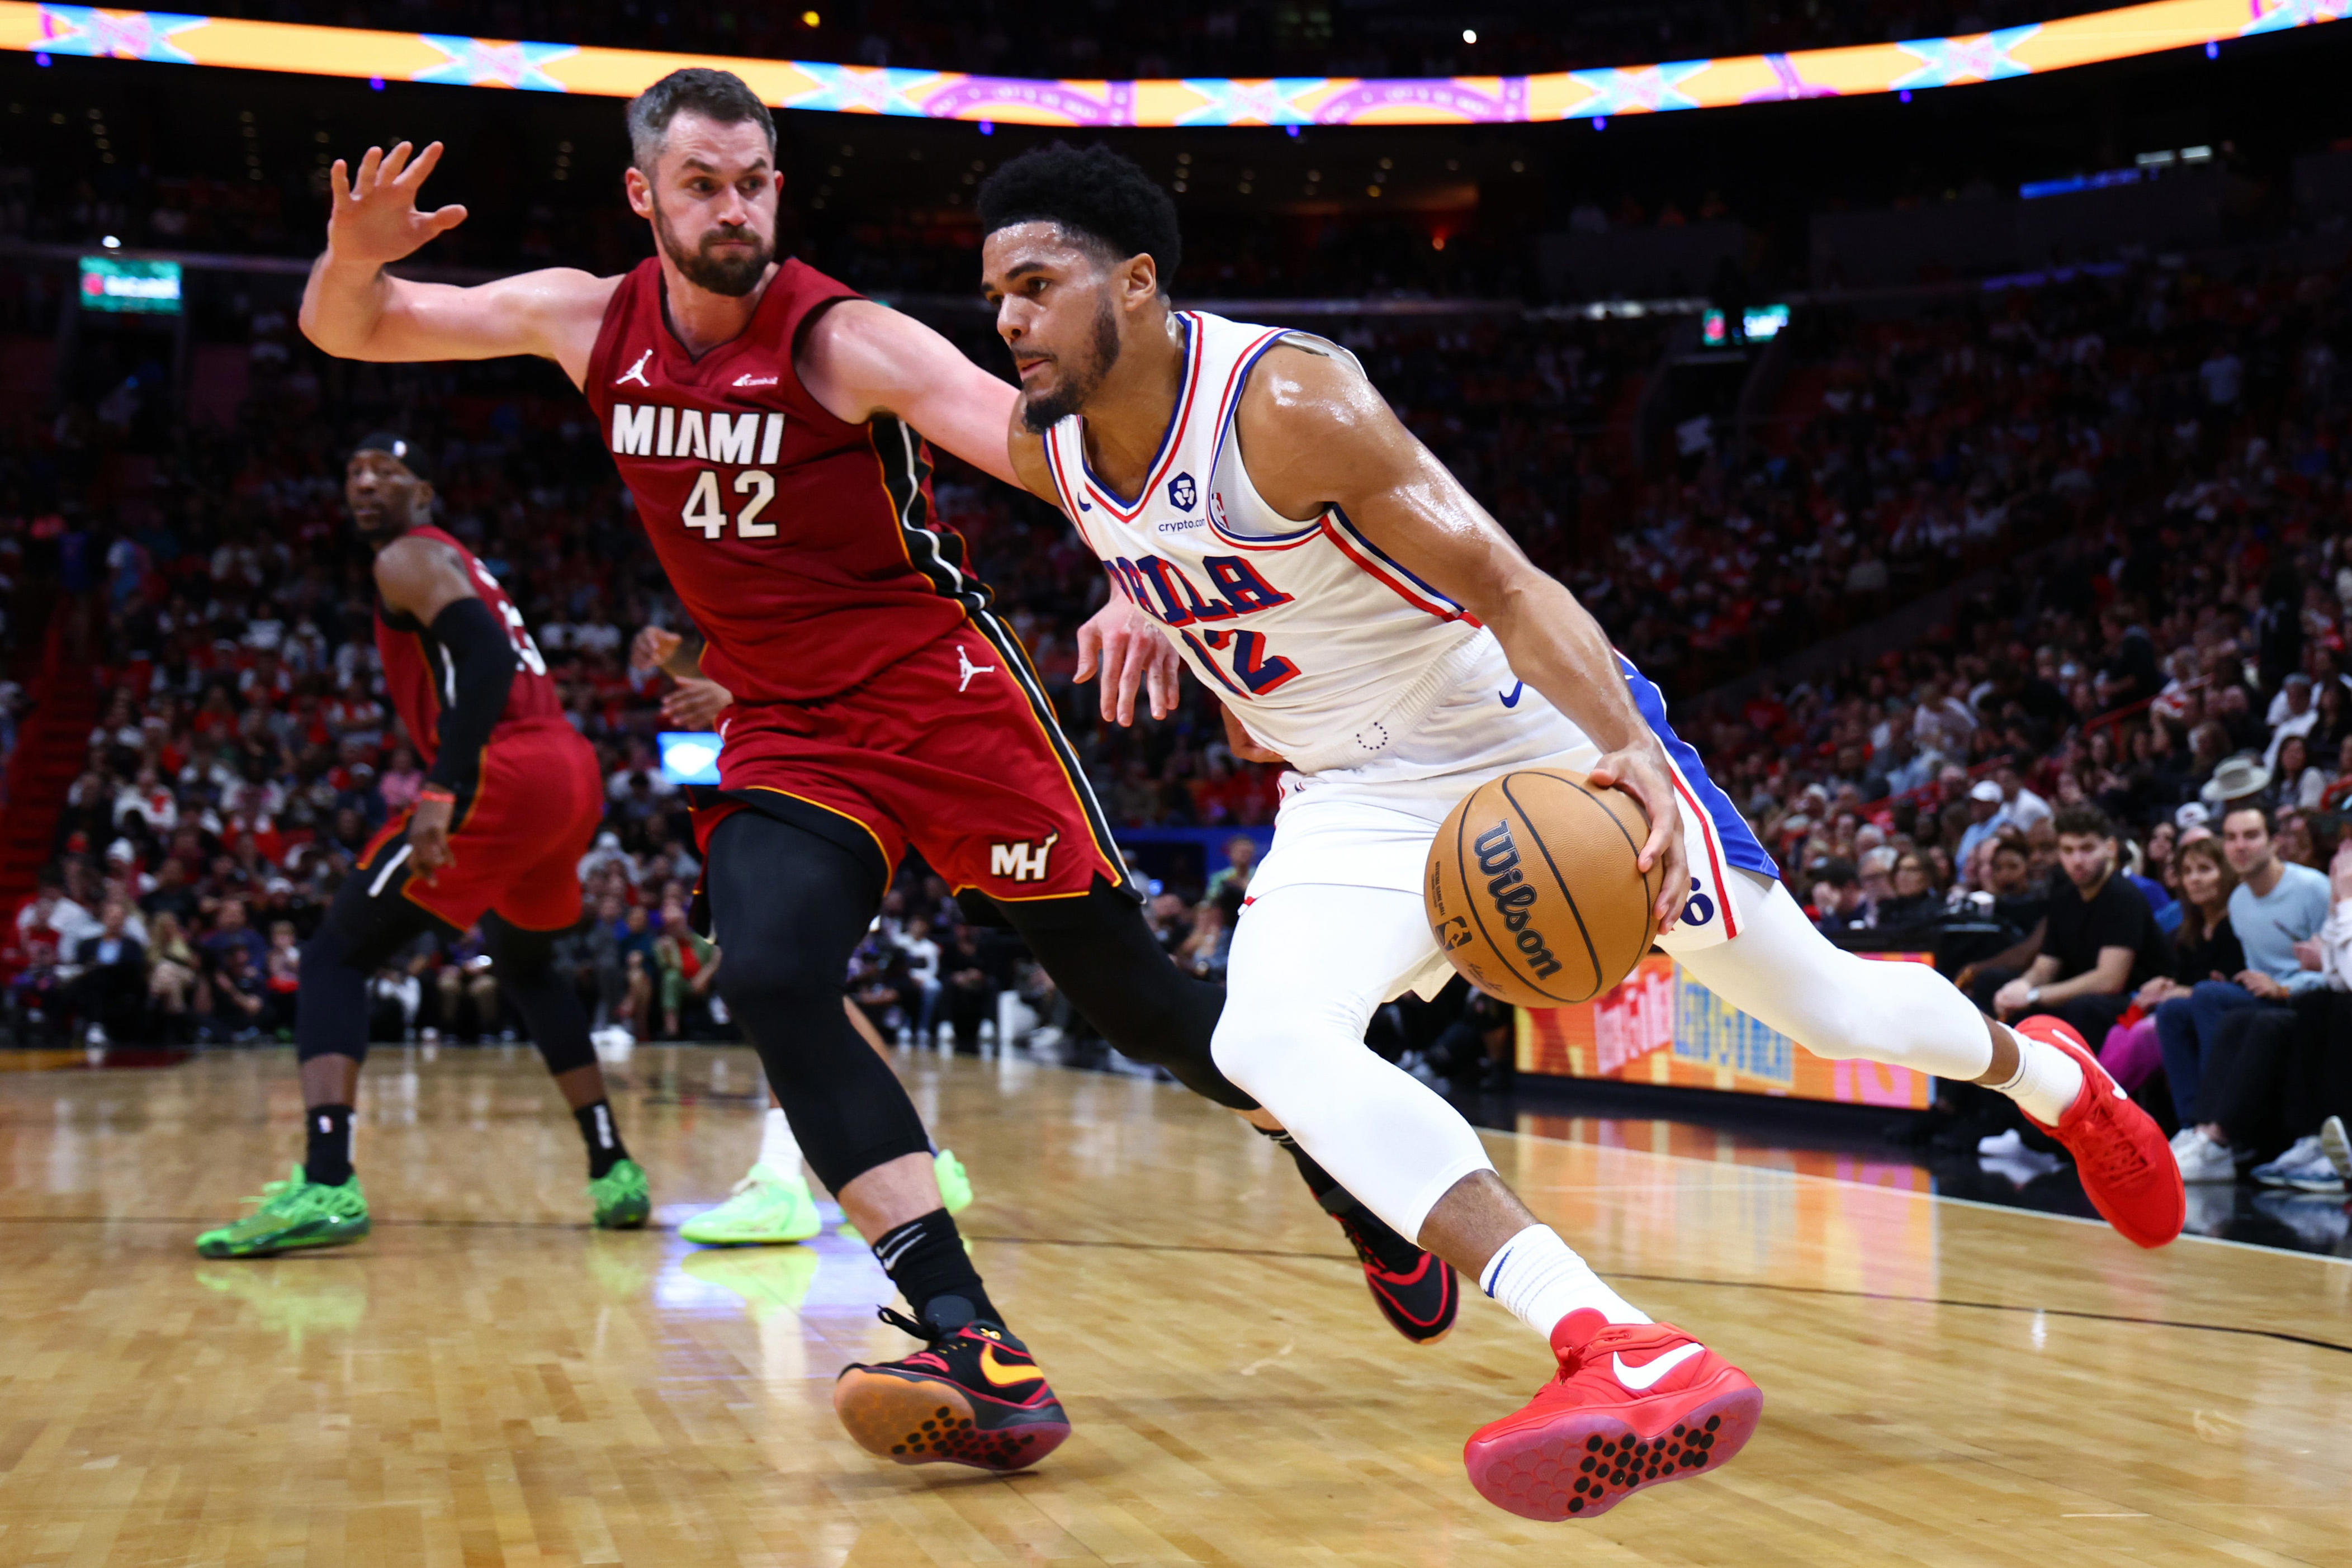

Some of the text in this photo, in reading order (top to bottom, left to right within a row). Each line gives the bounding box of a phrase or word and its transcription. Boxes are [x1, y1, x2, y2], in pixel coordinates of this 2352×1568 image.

[612, 403, 785, 465] MIAMI
[681, 470, 778, 539] 42
[1473, 818, 1563, 980] Wilson
